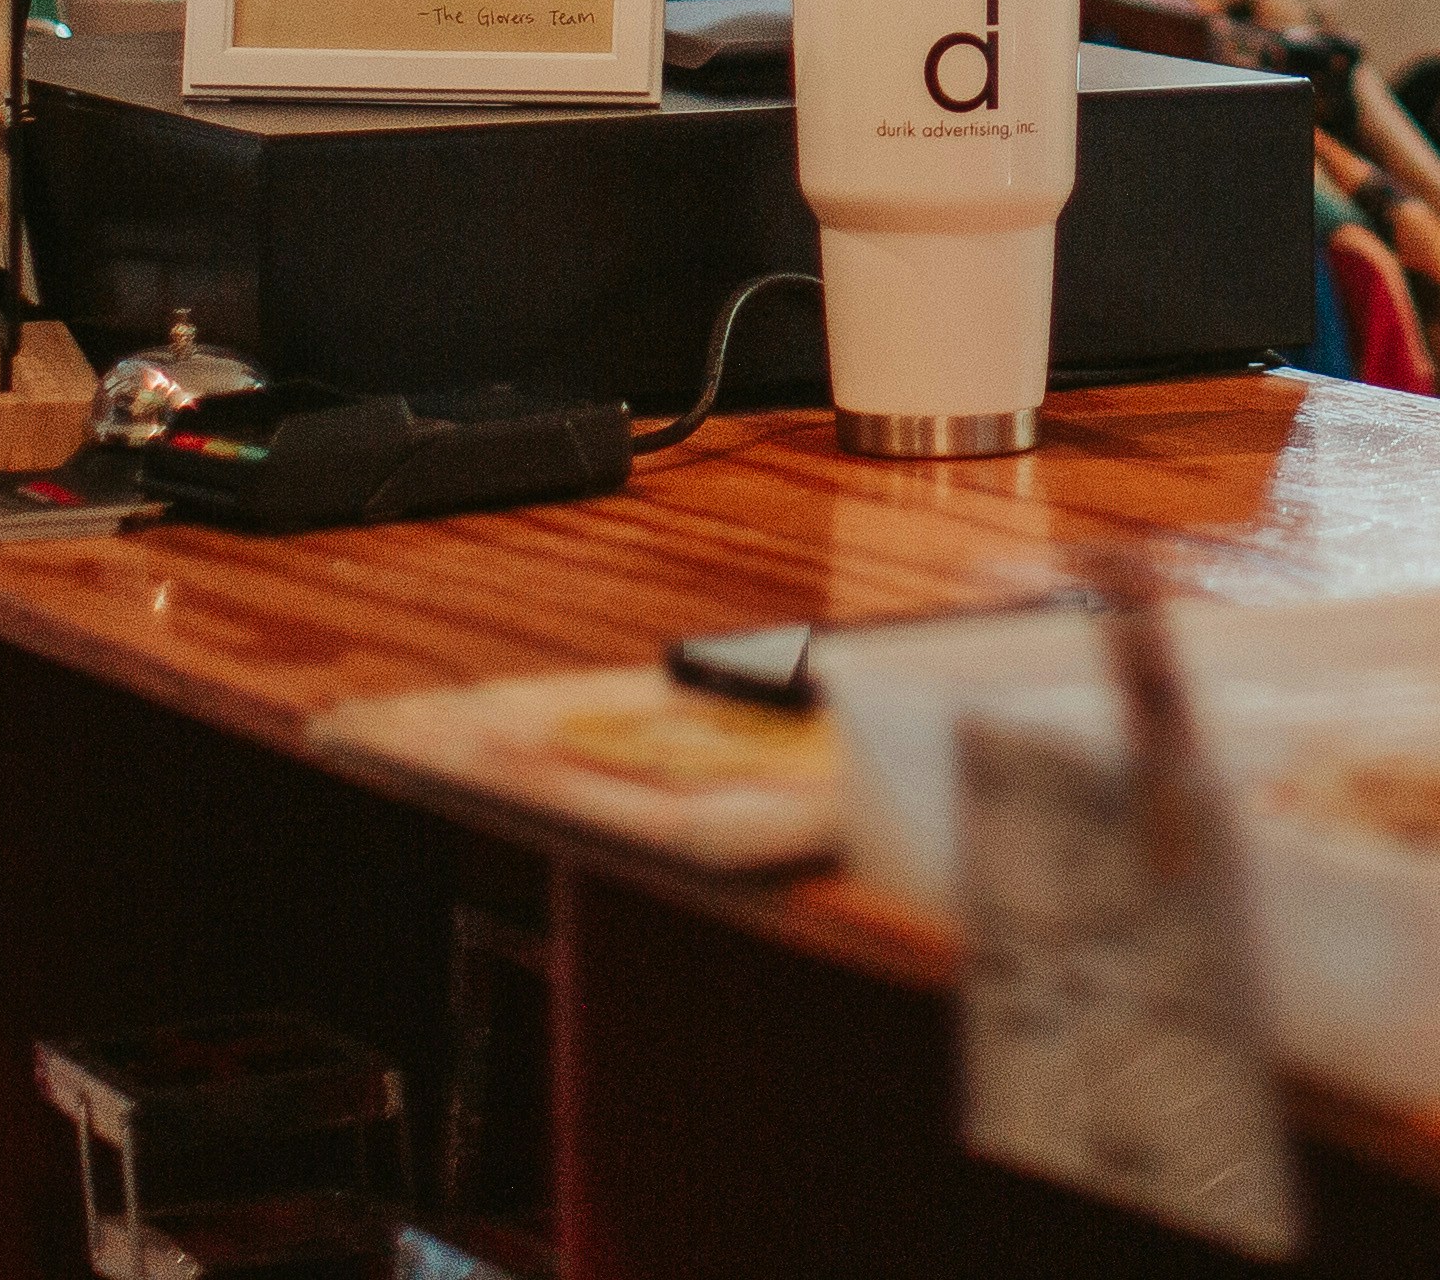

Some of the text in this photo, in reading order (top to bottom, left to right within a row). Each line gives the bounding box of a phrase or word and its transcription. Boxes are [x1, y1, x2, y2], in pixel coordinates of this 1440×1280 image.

[477, 8, 536, 26] Glovers
[548, 10, 596, 26] Team
[876, 118, 1039, 140] durik advertising, inc.
